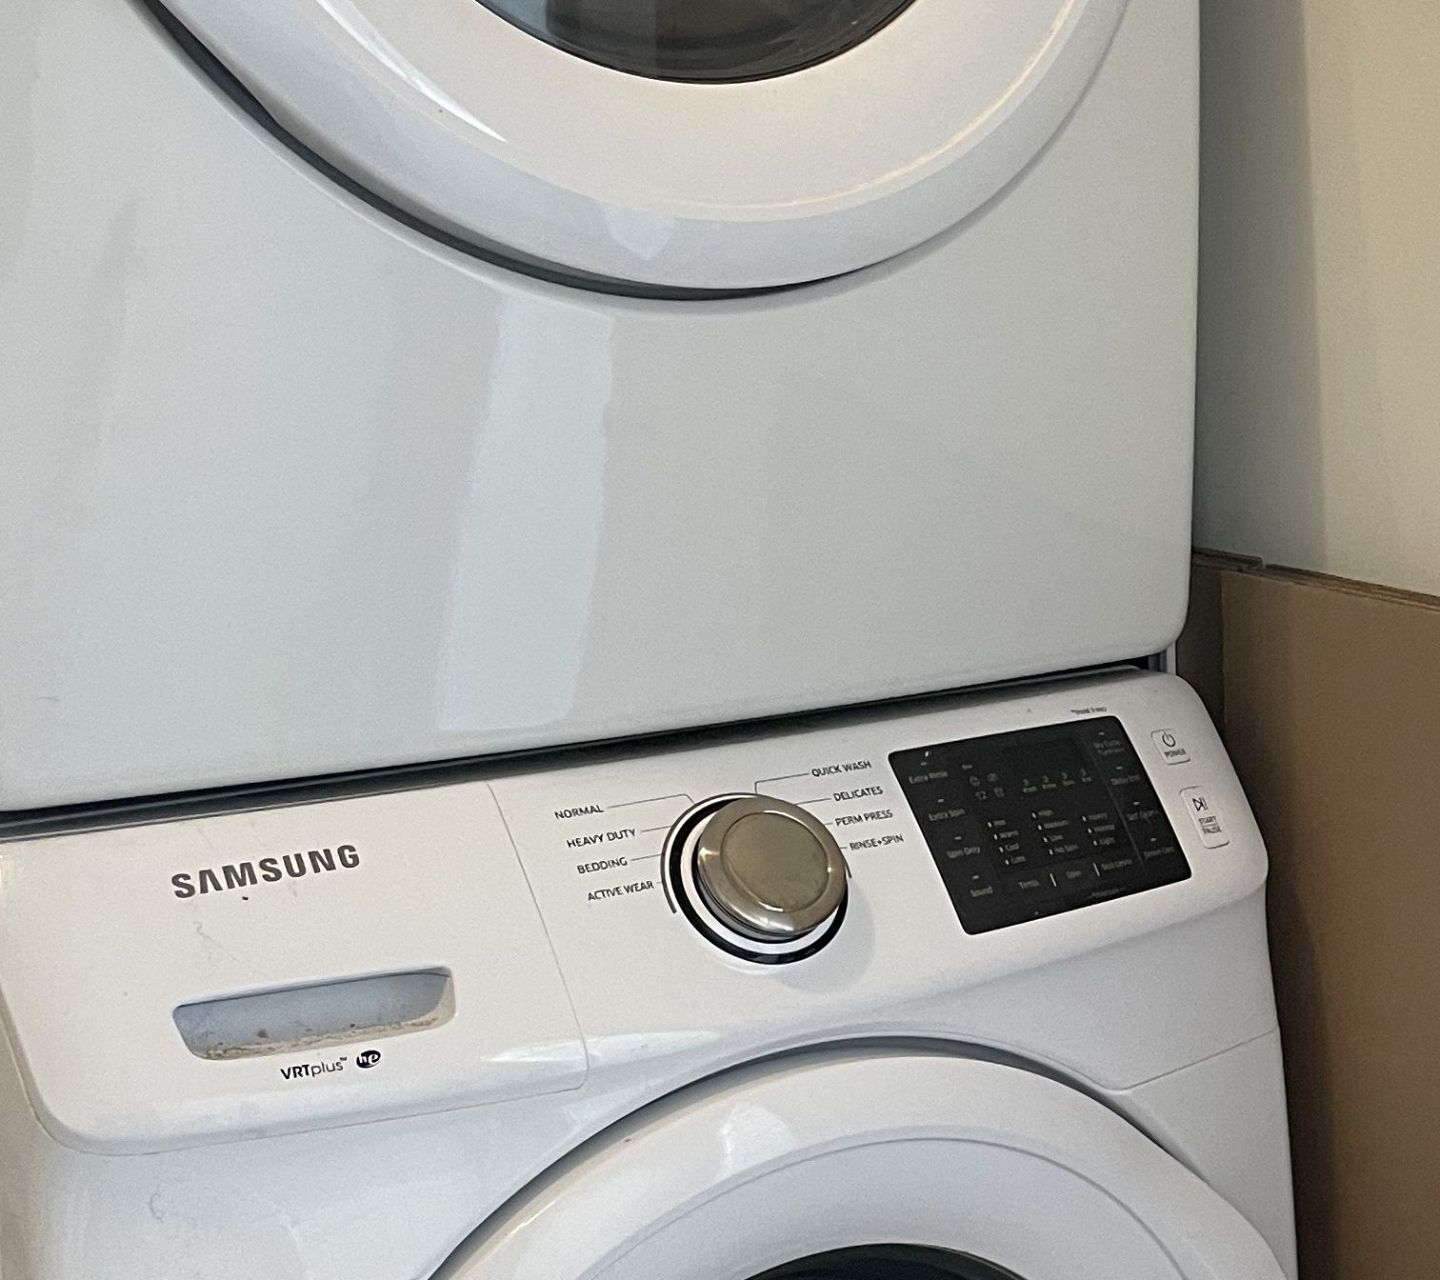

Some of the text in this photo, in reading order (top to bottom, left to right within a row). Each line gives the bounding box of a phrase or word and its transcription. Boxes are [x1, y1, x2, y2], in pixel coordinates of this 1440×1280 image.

[811, 760, 872, 777] QUICK WASH
[833, 786, 884, 802] DELICATES
[554, 805, 605, 820] NORMAL
[835, 809, 893, 827] PERM PRESS
[566, 828, 635, 849] HEAVY DUTY
[171, 844, 361, 899] SAMSUNG
[576, 857, 628, 875] BEDDING
[587, 880, 655, 901] ACTIVE WEAR
